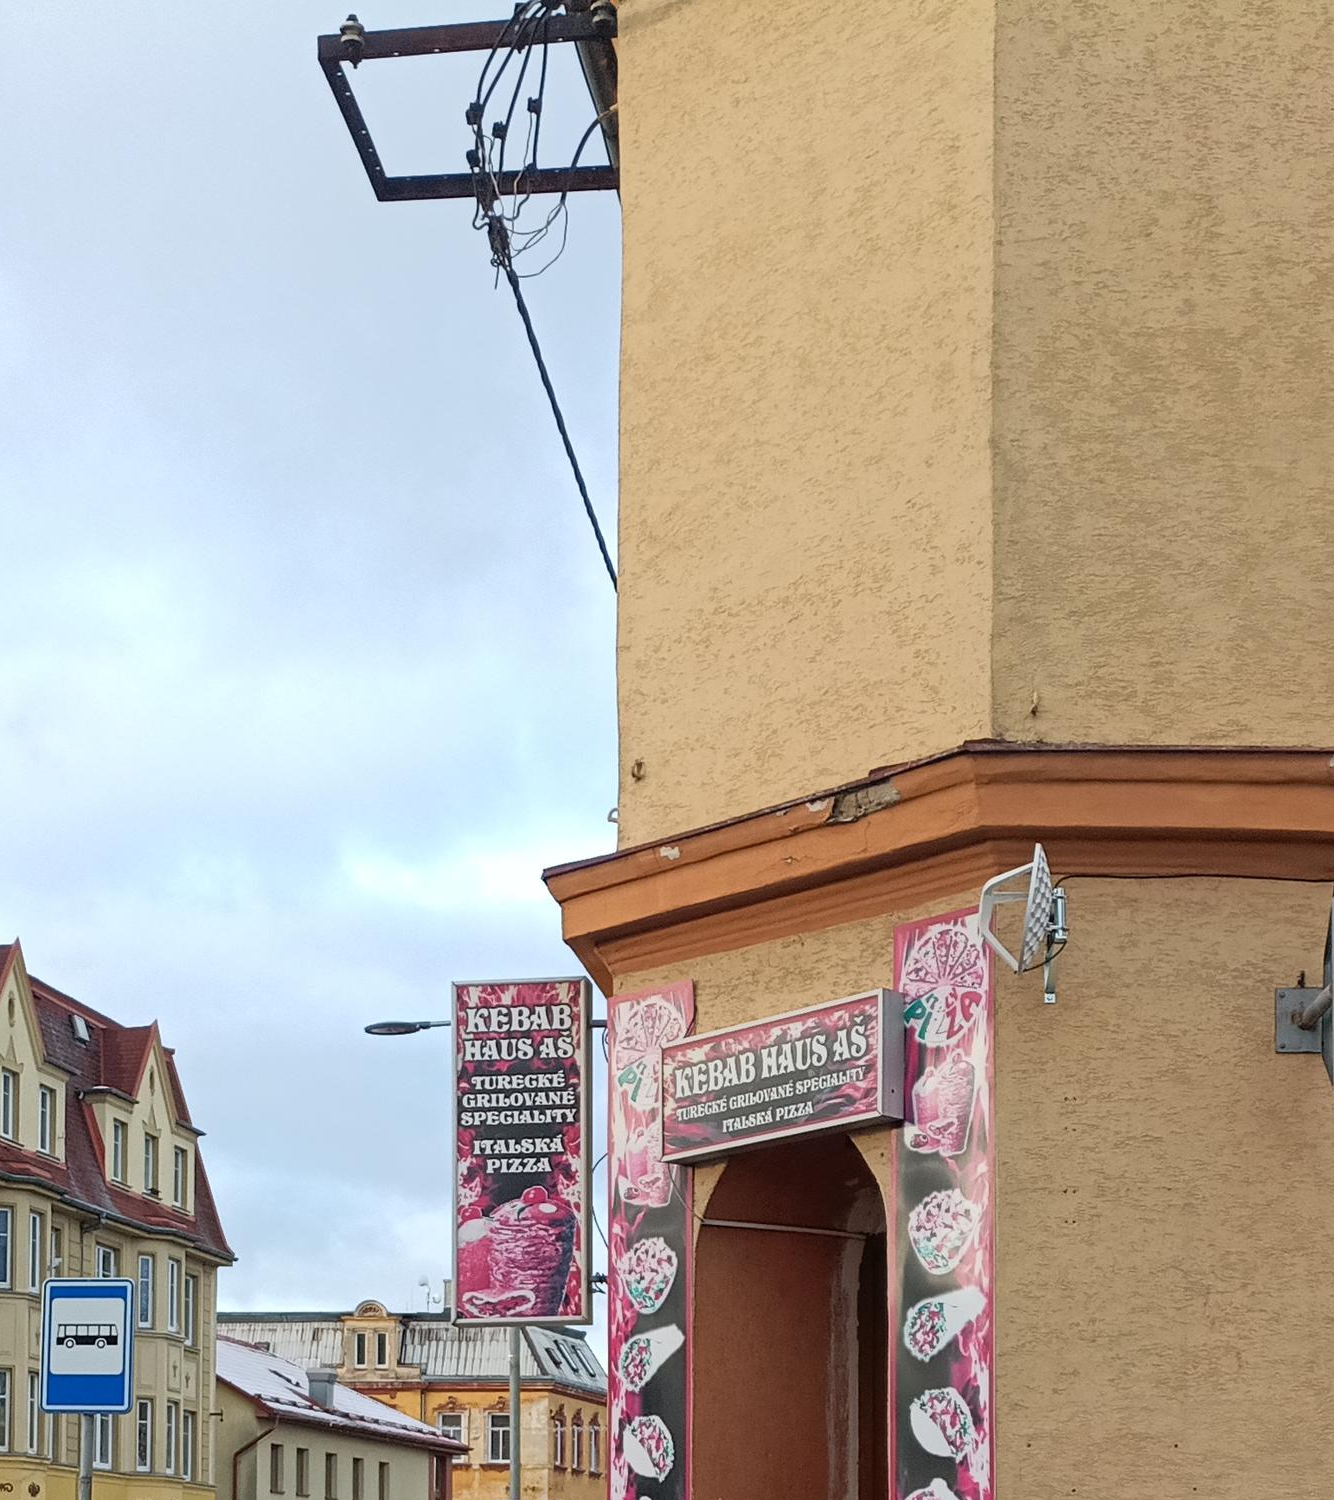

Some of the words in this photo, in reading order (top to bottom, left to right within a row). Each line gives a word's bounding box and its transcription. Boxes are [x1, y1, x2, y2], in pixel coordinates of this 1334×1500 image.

[465, 1004, 573, 1033] KEBAB
[464, 1037, 534, 1061] HAUS
[539, 1031, 574, 1059] AŠ
[675, 1053, 756, 1099] KEBAB
[761, 1034, 828, 1079] HAUS
[832, 1015, 867, 1062] AŠ
[471, 1070, 566, 1090] TURECKÉ
[462, 1087, 576, 1108] GRILOVANÉ
[676, 1096, 728, 1121] TURECKÉ
[729, 1081, 794, 1110] GRILOVANÉ
[795, 1066, 866, 1096] SPECIALITY
[460, 1109, 577, 1126] SPECIALITY
[722, 1106, 774, 1133] ITALSKÁ
[775, 1101, 814, 1122] PIZZA
[473, 1134, 565, 1155] ITALSKÁ
[486, 1157, 552, 1173] PIZZA
